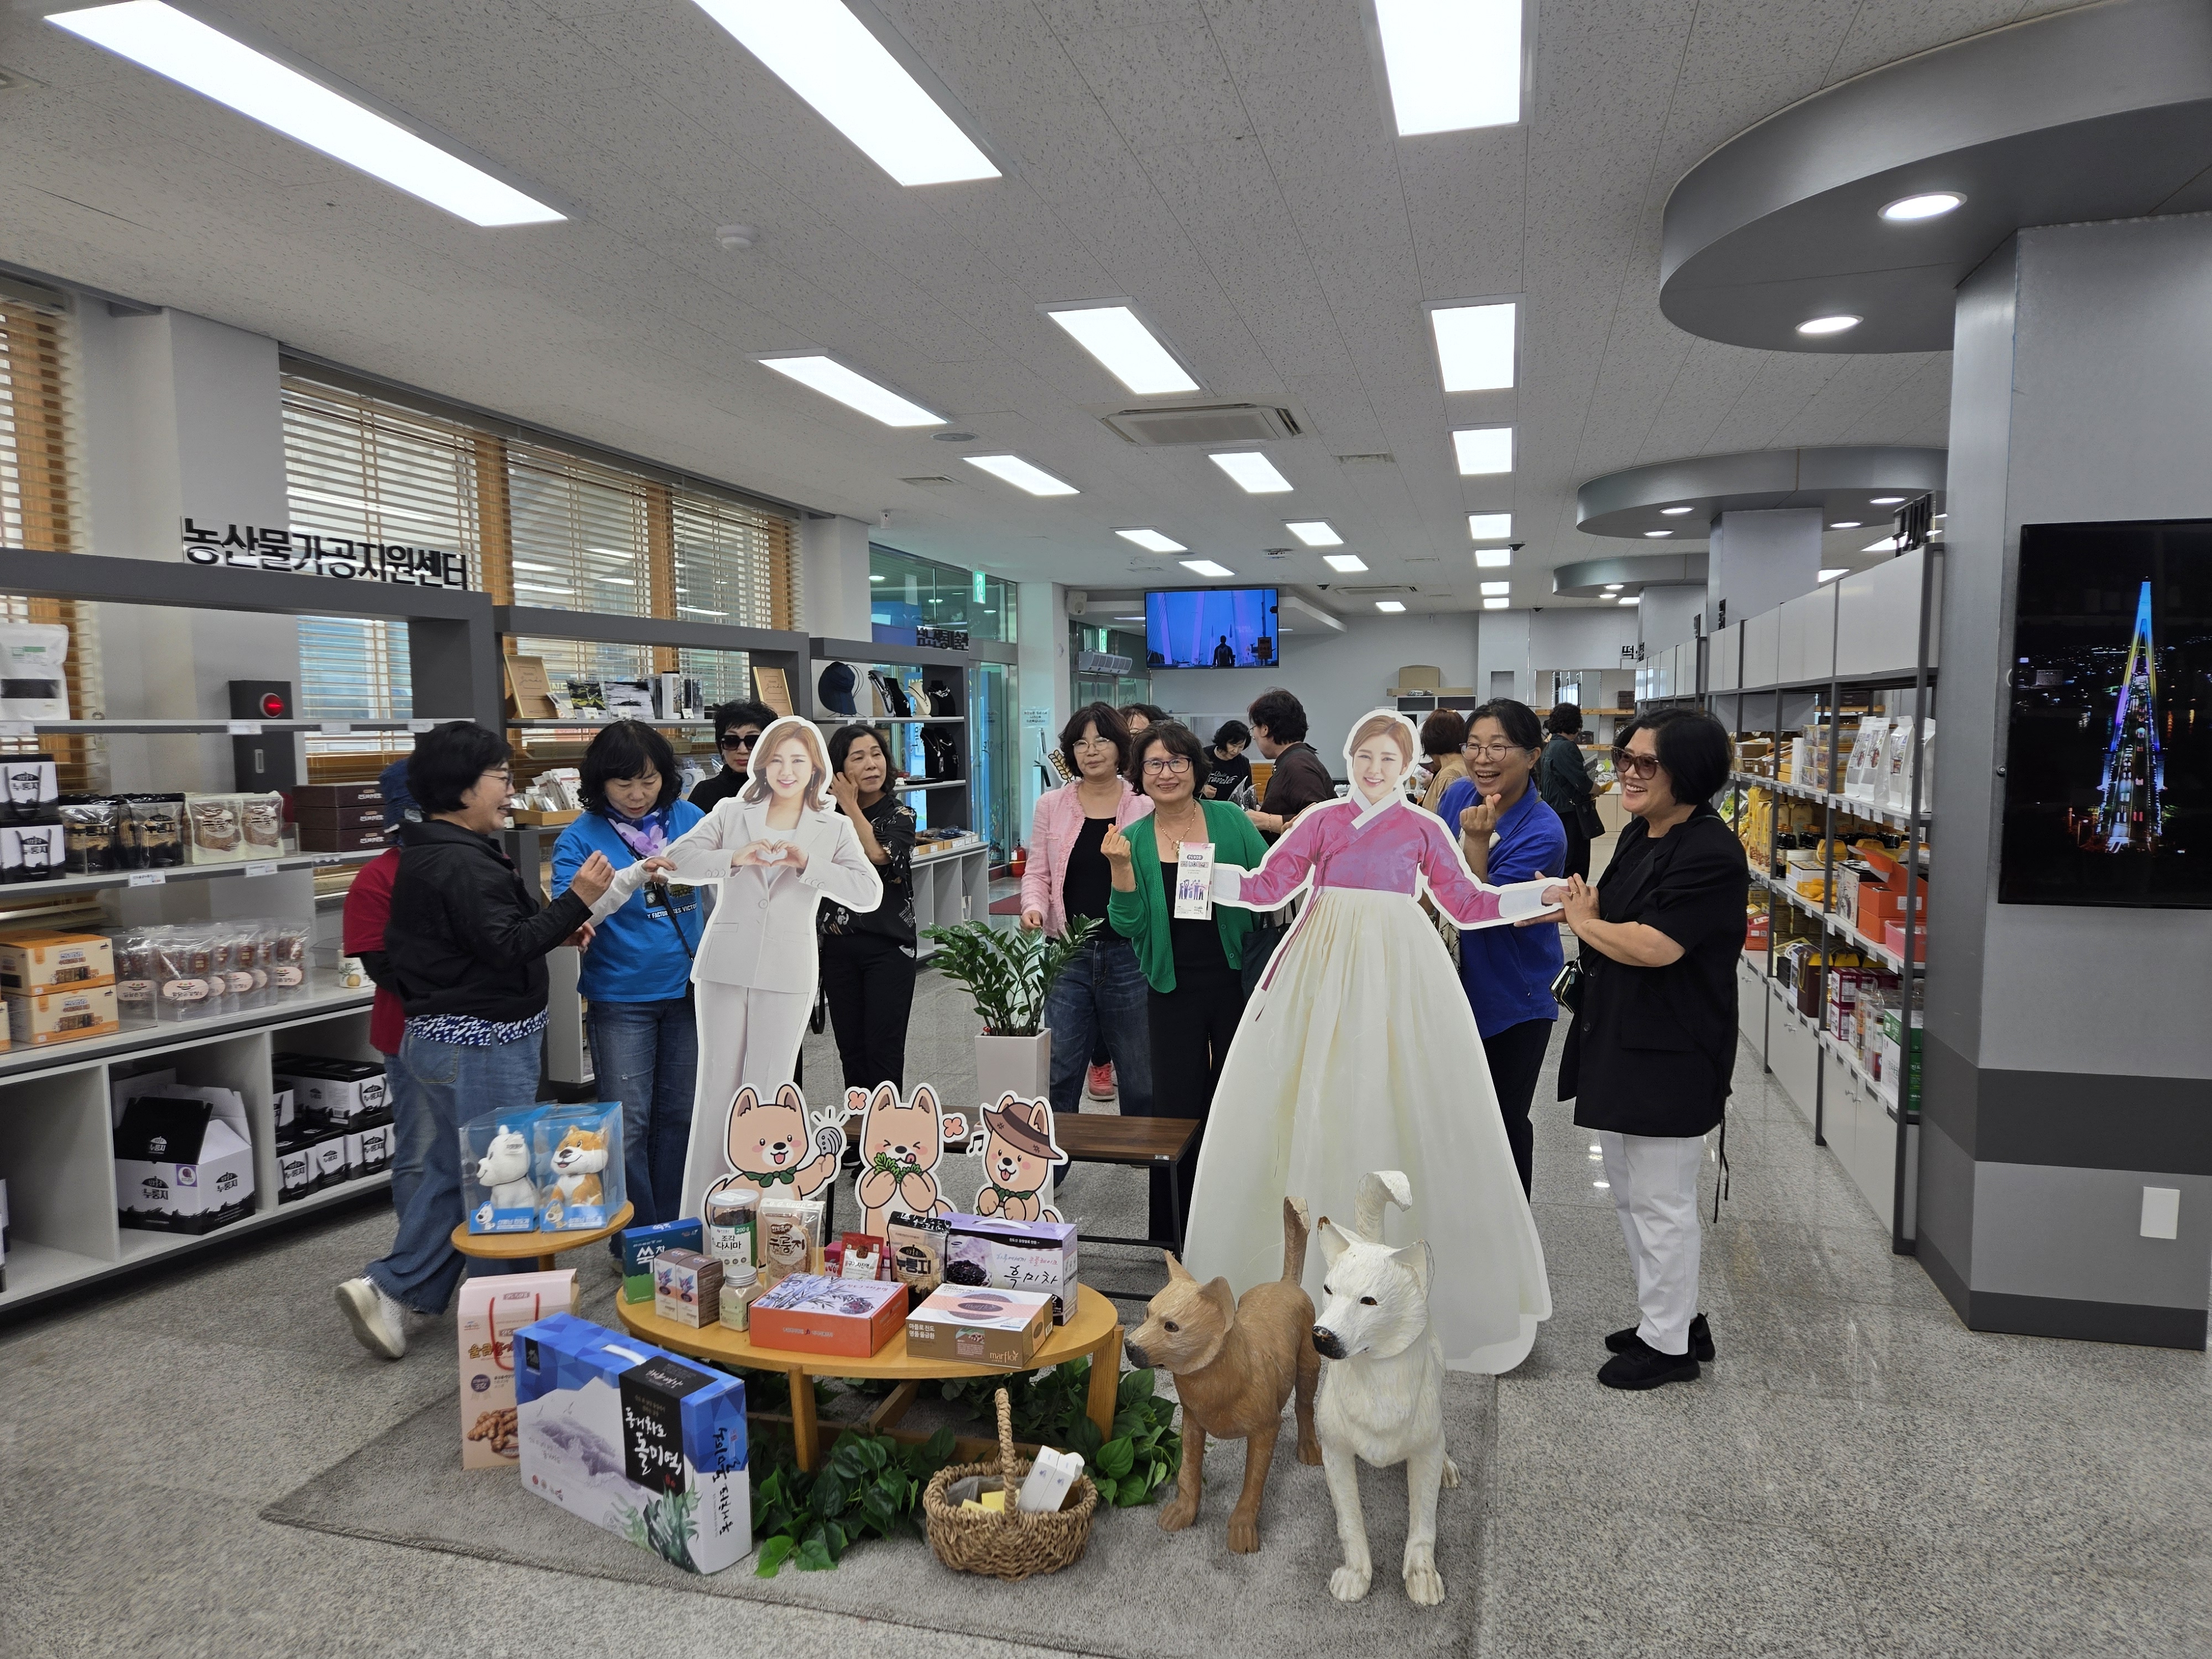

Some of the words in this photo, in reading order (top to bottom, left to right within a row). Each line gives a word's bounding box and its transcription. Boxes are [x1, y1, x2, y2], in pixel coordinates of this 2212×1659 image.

[183, 518, 468, 591] 농산물가공지원센터
[149, 1143, 166, 1152] 누룽지
[216, 1178, 238, 1193] 누룽지
[143, 1188, 169, 1201] 누룽지
[716, 1241, 742, 1250] 다시마
[896, 1255, 932, 1275] 누룽지
[1003, 1265, 1058, 1289] 흑미차
[909, 1323, 925, 1331] 마플로
[989, 1350, 1019, 1363] marflor
[634, 1431, 682, 1476] 돌미역
